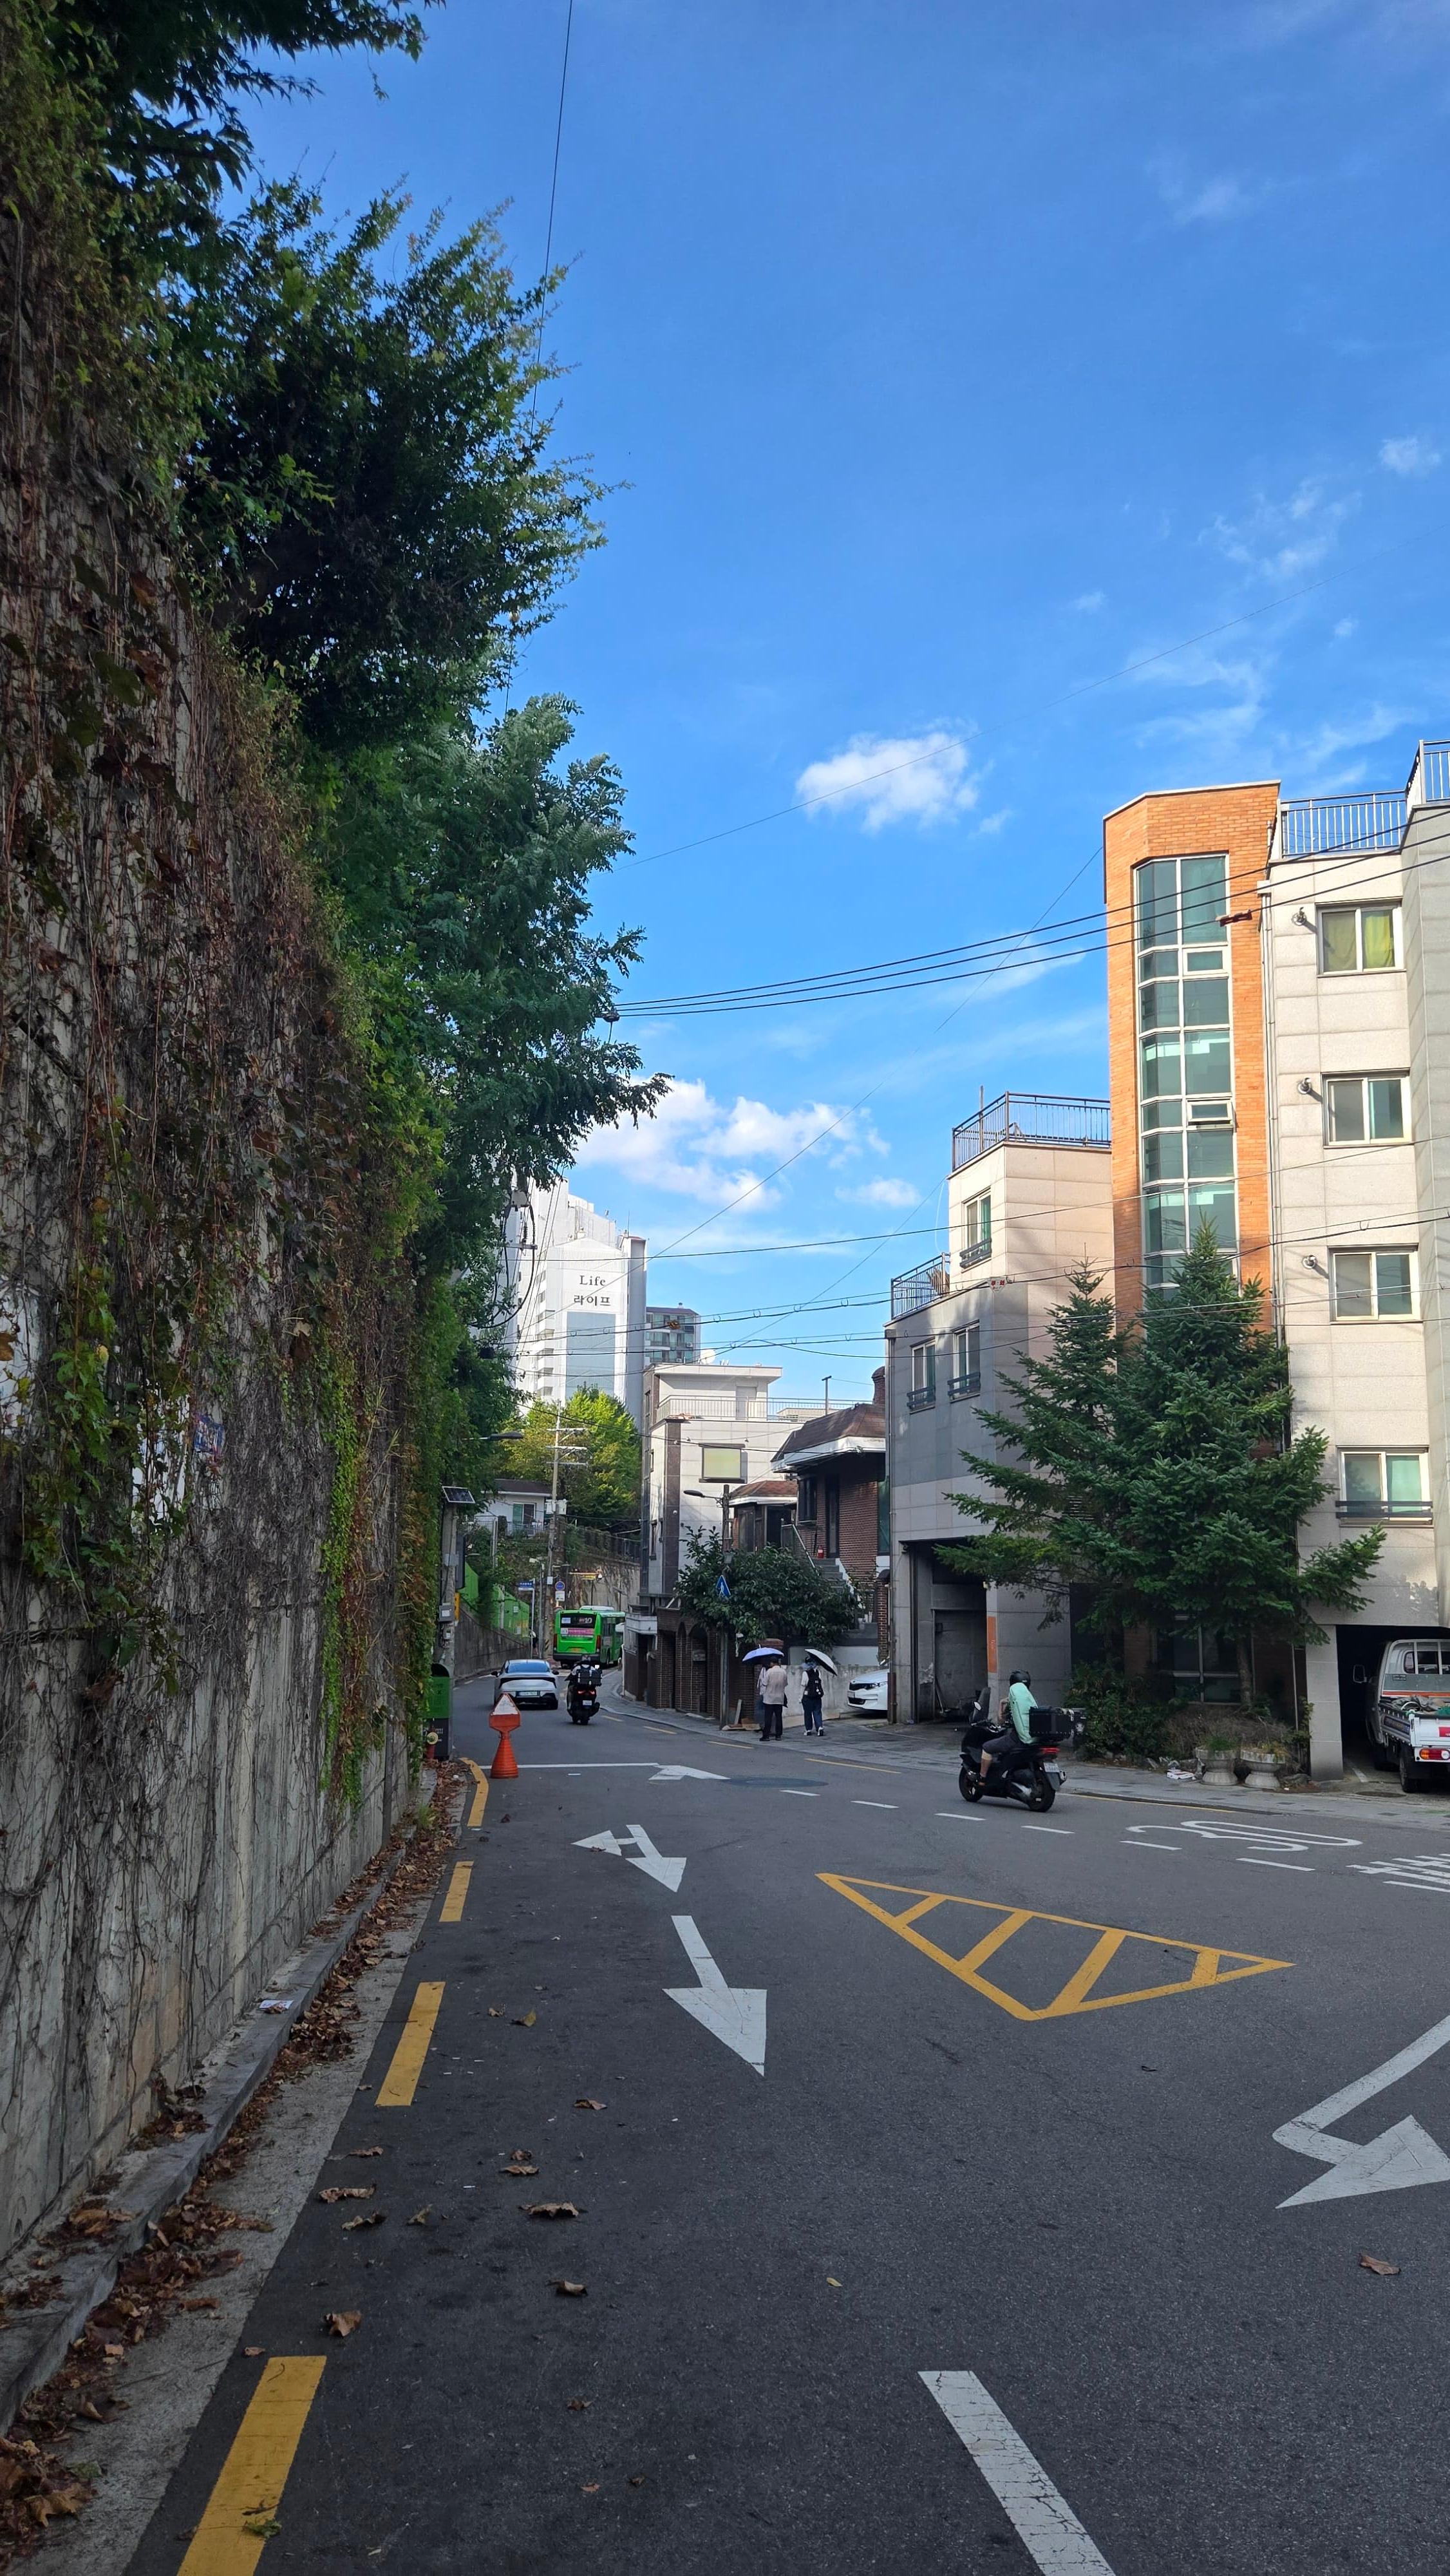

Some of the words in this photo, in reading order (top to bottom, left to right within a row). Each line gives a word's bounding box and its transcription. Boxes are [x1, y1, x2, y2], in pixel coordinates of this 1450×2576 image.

[579, 1275, 606, 1286] Life
[574, 1295, 611, 1306] 라이프
[1125, 1821, 1364, 1852] 30
